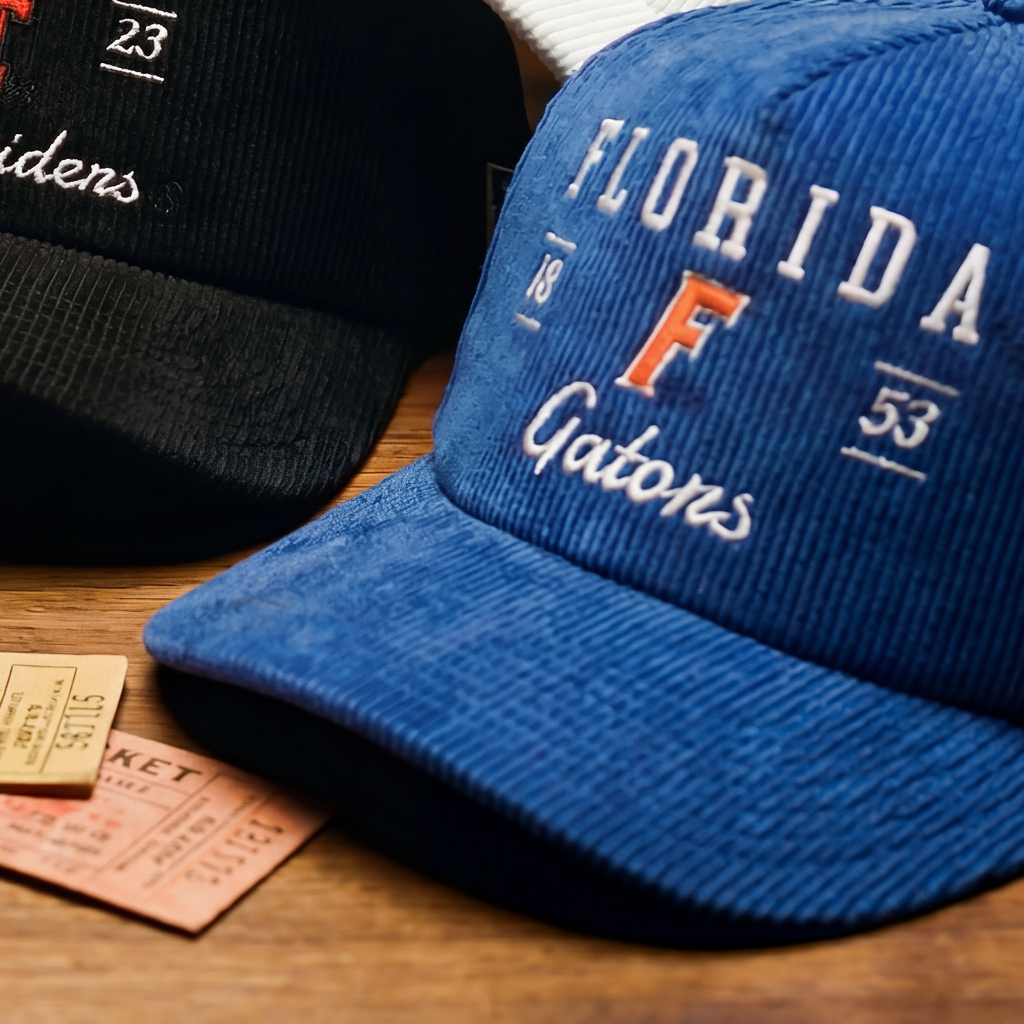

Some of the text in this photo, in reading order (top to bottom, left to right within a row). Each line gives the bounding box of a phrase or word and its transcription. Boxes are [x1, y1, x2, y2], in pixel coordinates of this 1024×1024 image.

[106, 18, 169, 61] 23
[564, 118, 991, 345] FLORIDA
[526, 254, 564, 304] 18
[615, 269, 750, 397] F
[859, 386, 941, 449] 53
